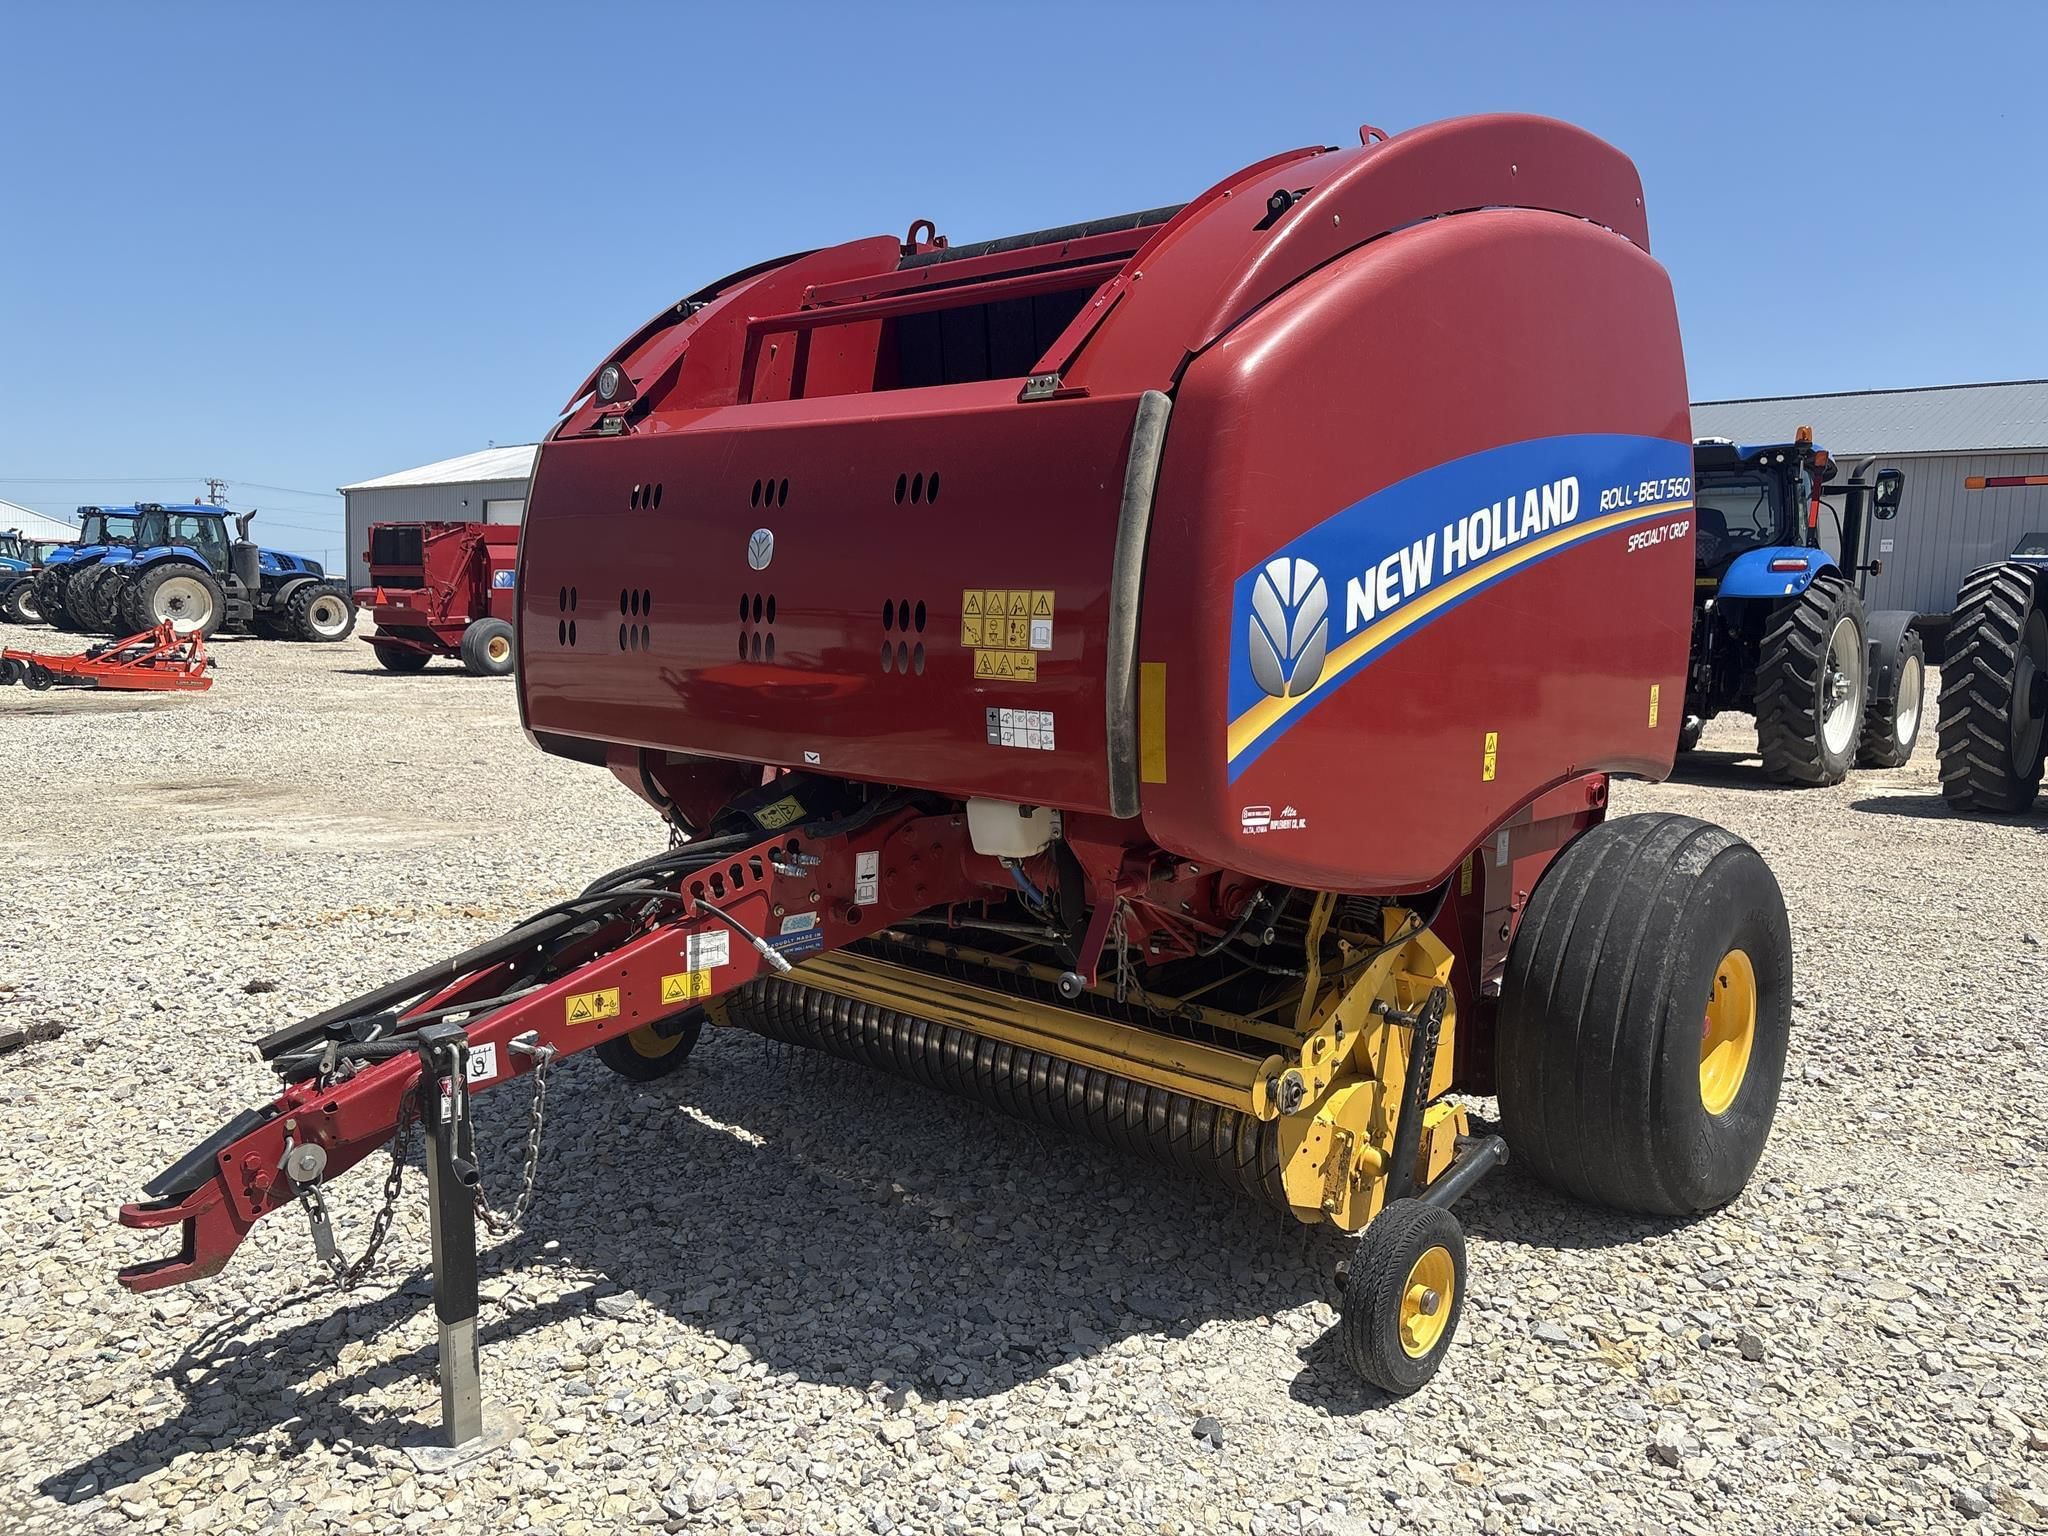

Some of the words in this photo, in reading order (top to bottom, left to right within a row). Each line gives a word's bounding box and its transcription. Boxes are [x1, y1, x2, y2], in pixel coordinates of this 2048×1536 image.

[1666, 477, 1691, 499] 560
[1627, 525, 1669, 553] SPECIALTY
[1668, 520, 1690, 540] CROP
[1345, 532, 1436, 634] NEW
[1442, 476, 1580, 576] HOLLAND
